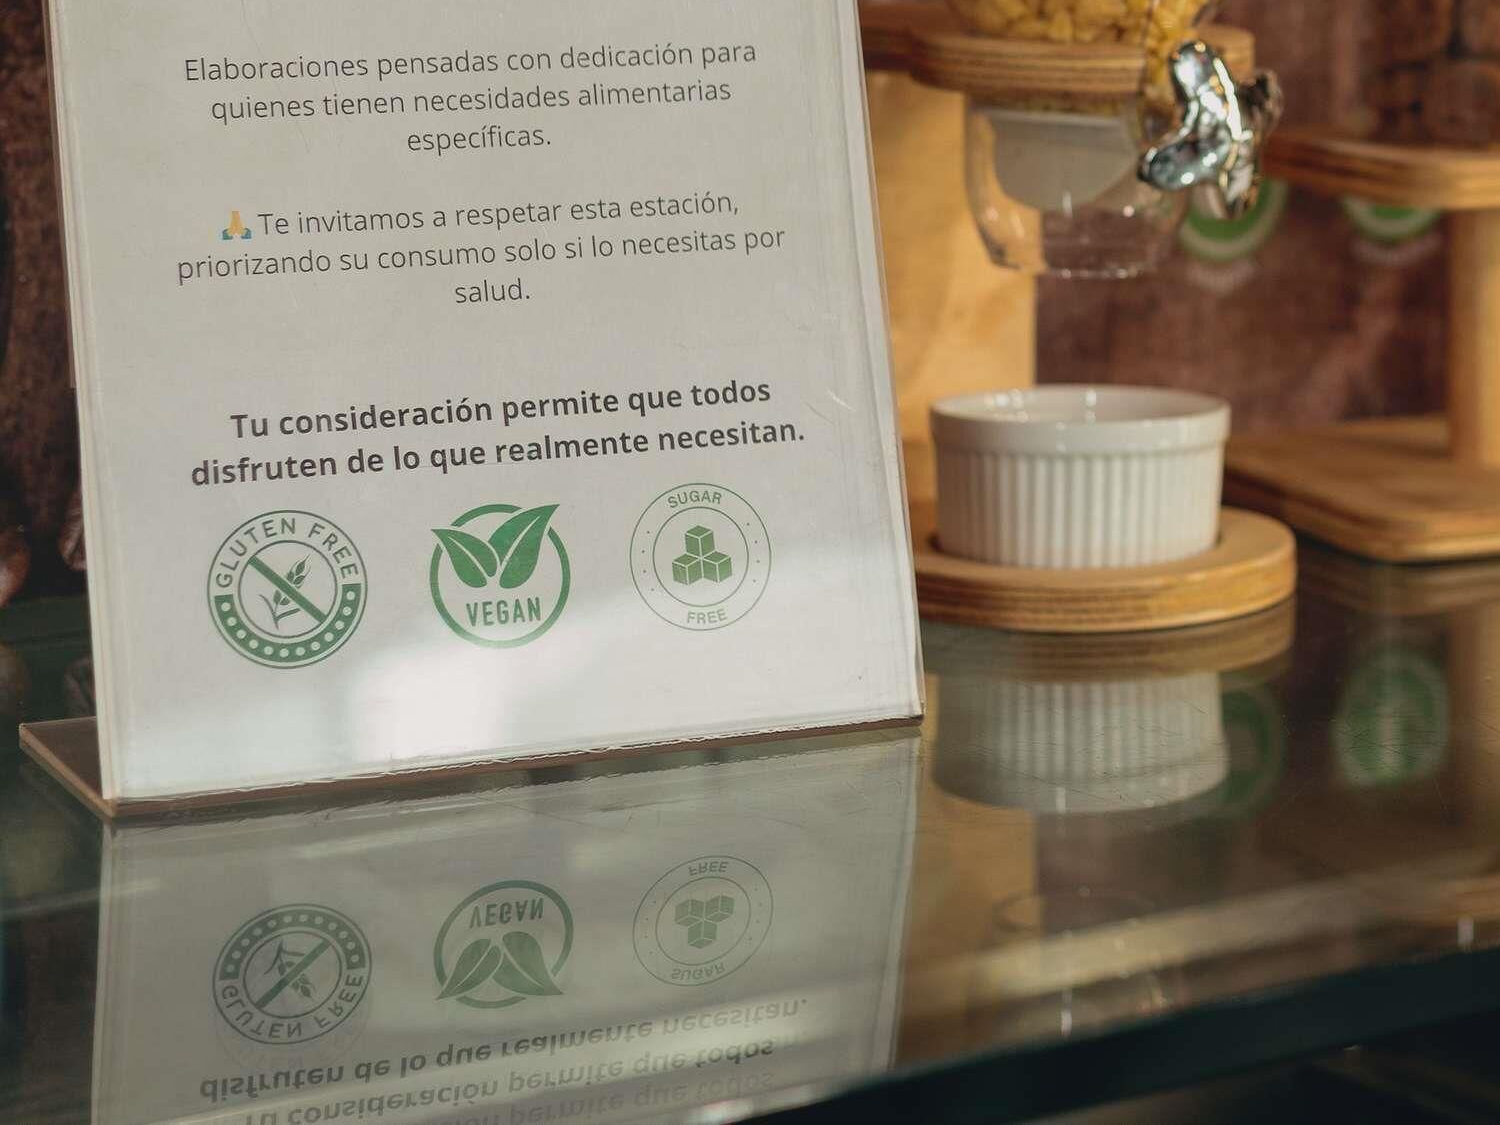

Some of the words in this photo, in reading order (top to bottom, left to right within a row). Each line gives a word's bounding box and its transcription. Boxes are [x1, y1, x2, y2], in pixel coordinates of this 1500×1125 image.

[184, 55, 369, 83] Elaboraciones
[377, 49, 499, 82] pensadas
[507, 52, 552, 71] con
[560, 42, 693, 69] dedicación
[701, 44, 756, 70] para
[209, 96, 315, 126] quienes
[322, 93, 406, 116] tienen
[413, 84, 570, 113] necesidades
[578, 79, 732, 107] alimentarias
[407, 122, 551, 157] específicas.
[256, 213, 289, 236] Te
[297, 209, 425, 234] invitamos
[432, 210, 447, 228] a
[455, 202, 563, 231] respetar
[570, 198, 622, 221] esta
[629, 190, 739, 218] estación,
[177, 249, 331, 285] priorizando
[339, 251, 369, 274] su
[376, 246, 496, 269] consumo
[504, 237, 557, 263] solo
[564, 236, 583, 260] si
[591, 234, 614, 259] lo
[622, 230, 737, 256] necesitas
[744, 230, 786, 256] por
[454, 276, 531, 304] salud.
[229, 413, 269, 439] Tu
[279, 396, 493, 436] consideración
[501, 389, 619, 427] permite
[627, 389, 683, 418] que
[689, 378, 771, 407] todos
[191, 456, 338, 487] disfruten
[347, 447, 385, 474] de
[393, 445, 421, 471] lo
[429, 446, 486, 475] que
[495, 431, 649, 464] realmente
[657, 420, 805, 452] necesitan.
[667, 490, 723, 509] SUGAR
[215, 517, 296, 588] GLUTEN
[307, 522, 359, 579] FREE
[465, 596, 542, 628] VEGAN
[686, 608, 728, 625] FREE
